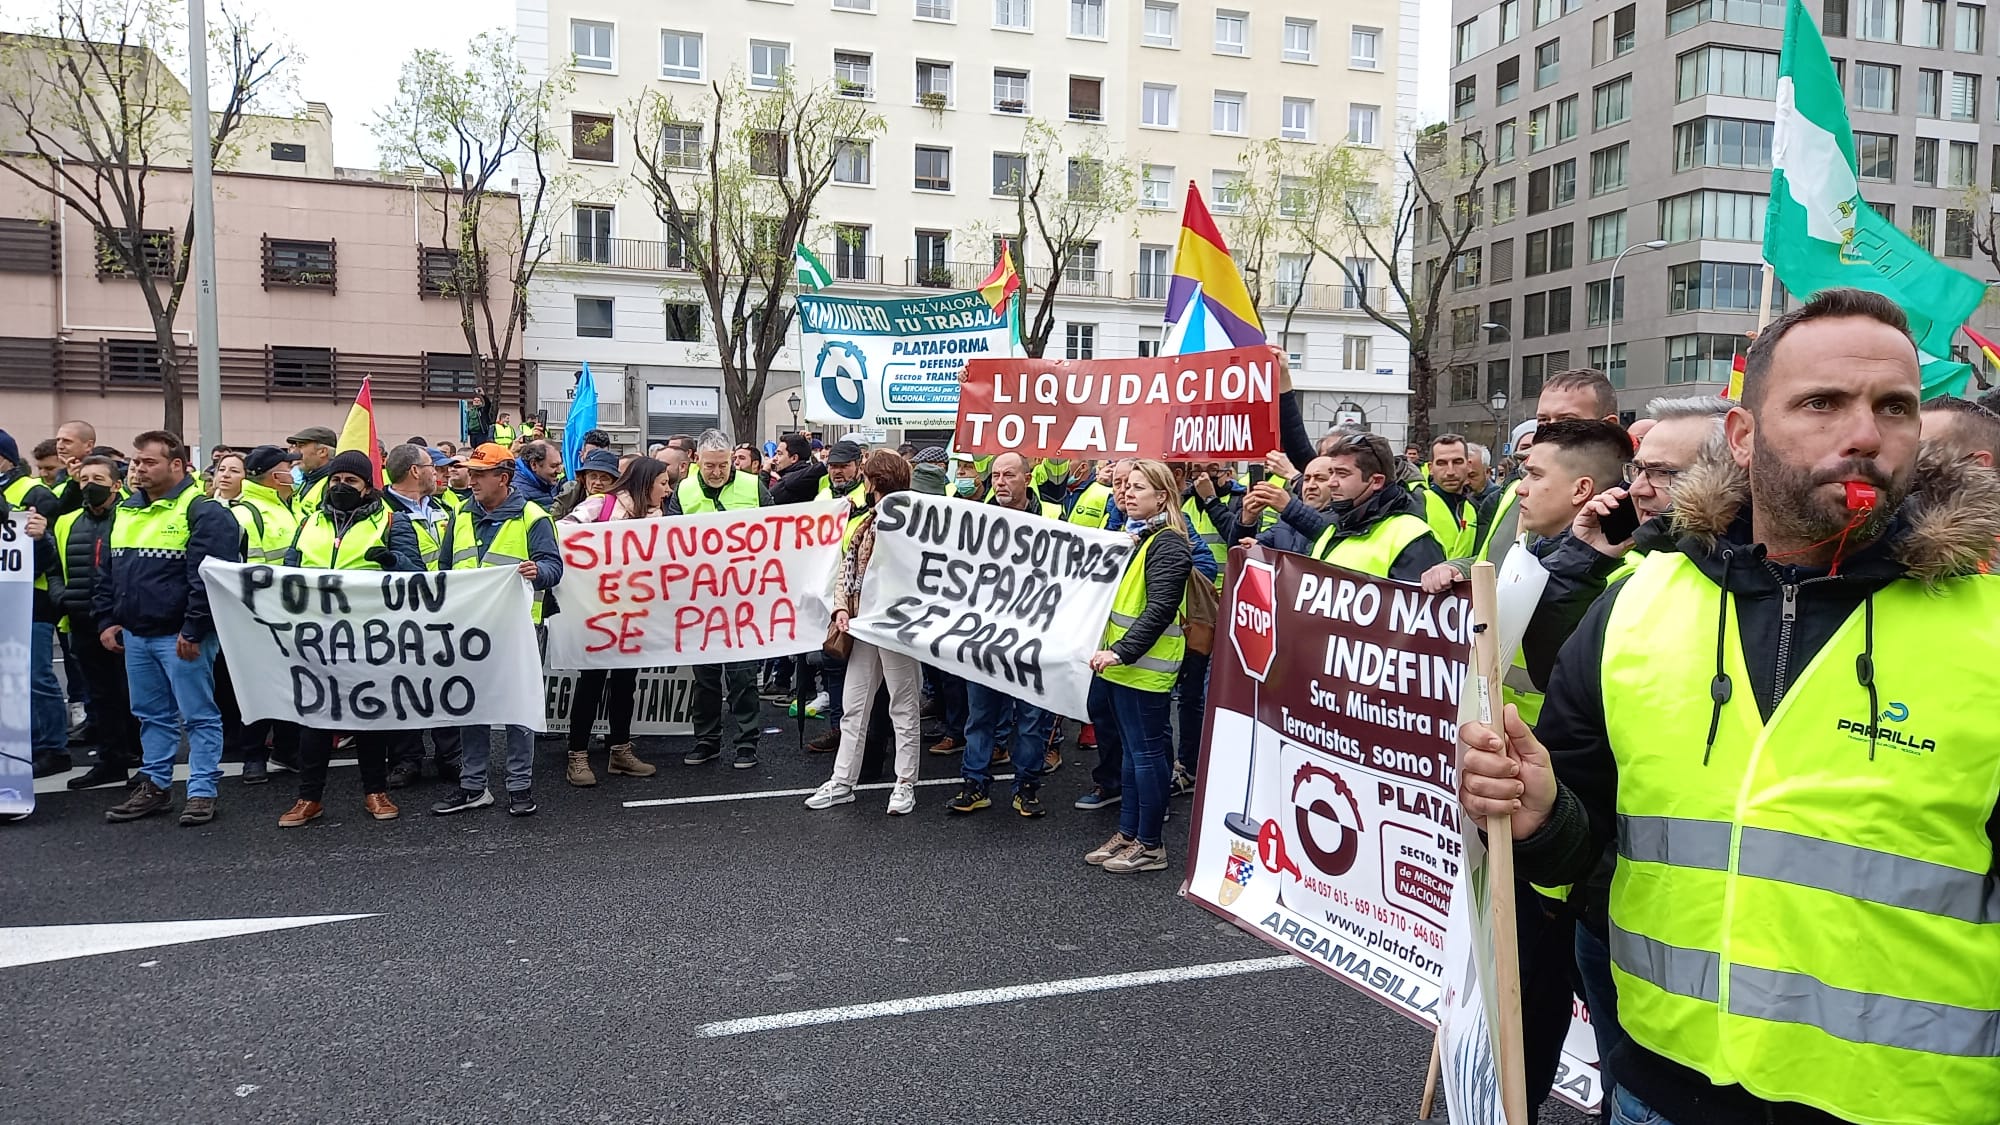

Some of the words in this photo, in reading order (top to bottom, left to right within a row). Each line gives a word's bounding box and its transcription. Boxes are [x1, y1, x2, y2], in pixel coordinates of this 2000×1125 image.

[895, 318, 921, 333] TU
[902, 303, 927, 316] HAZ
[892, 337, 989, 356] PLATAFORMA
[920, 358, 965, 369] DEFENSA
[892, 394, 926, 402] NACIONAL
[901, 385, 942, 393] MERCANCIAS
[993, 361, 1274, 406] LIQUIDACION
[966, 412, 1140, 453] TOTAL
[1172, 415, 1207, 453] POR
[1208, 413, 1255, 453] RUINA
[564, 524, 660, 571] SIN
[667, 511, 849, 562] NOSOTROS
[876, 497, 953, 546] SIN
[958, 508, 1134, 584] NOSOTROS
[240, 564, 351, 615] POR
[381, 571, 447, 613] UN
[599, 556, 788, 604] ESPAÑA
[917, 552, 1063, 633] ESPAÑA
[1294, 573, 1382, 627] PARO
[254, 616, 492, 668] TRABAJO
[583, 609, 648, 656] SE
[673, 598, 797, 654] PARA
[1237, 601, 1271, 637] STOP
[873, 596, 949, 643] SE
[930, 612, 1046, 697] PARA
[291, 665, 476, 722] DIGNO
[1310, 680, 1341, 714] Sra.
[1346, 691, 1432, 735] Ministra
[1281, 707, 1366, 764] Terroristas,
[1372, 745, 1433, 777] somo
[1400, 845, 1437, 868] SECTOR
[1437, 833, 1462, 858] DEF
[1400, 866, 1412, 878] de
[1304, 875, 1317, 893] 648
[1318, 881, 1332, 899] 057
[1334, 888, 1348, 906] 615
[1355, 898, 1370, 916] 659
[1373, 904, 1388, 924] 165
[1391, 910, 1406, 932] 710
[1414, 922, 1428, 943] 646
